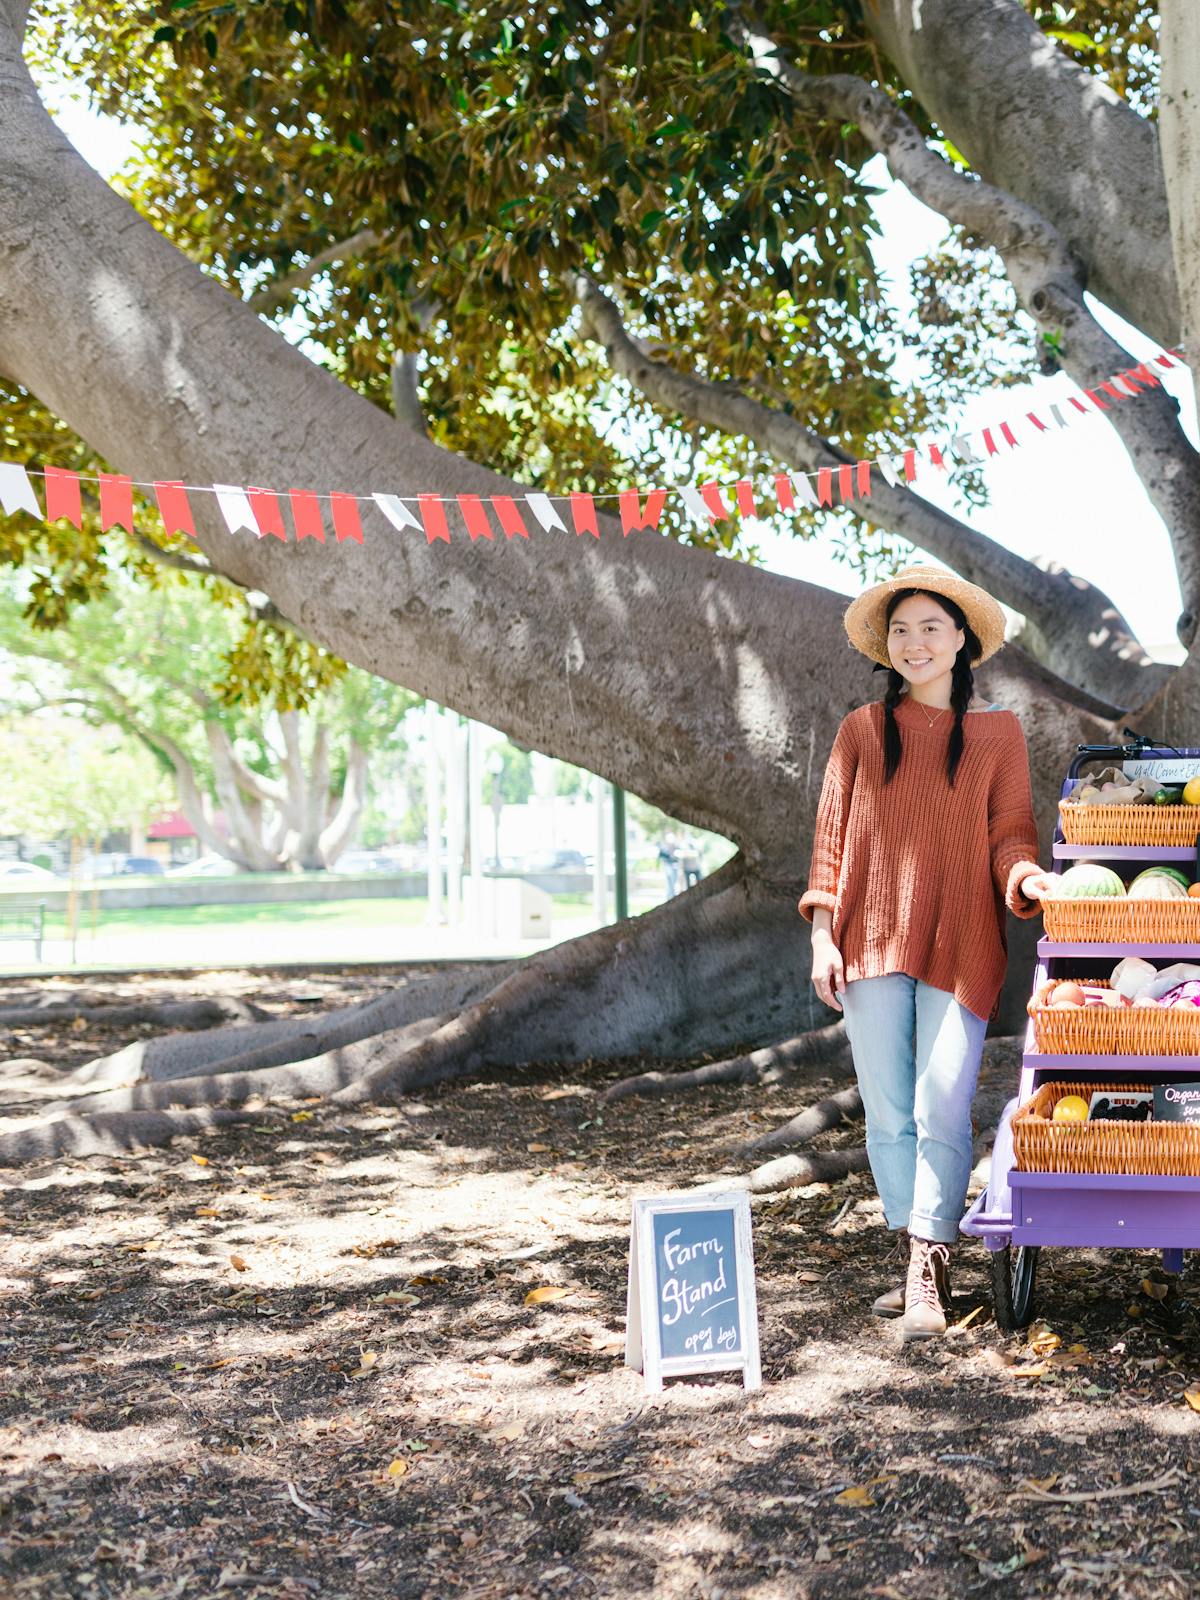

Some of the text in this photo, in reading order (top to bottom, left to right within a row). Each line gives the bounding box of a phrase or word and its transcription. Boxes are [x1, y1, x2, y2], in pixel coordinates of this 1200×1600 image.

[1156, 762, 1178, 780] Come
[1185, 763, 1200, 779] Eat
[663, 1228, 724, 1271] Farm
[662, 1257, 727, 1326] Stand
[684, 1326, 712, 1353] open
[716, 1325, 737, 1350] day
